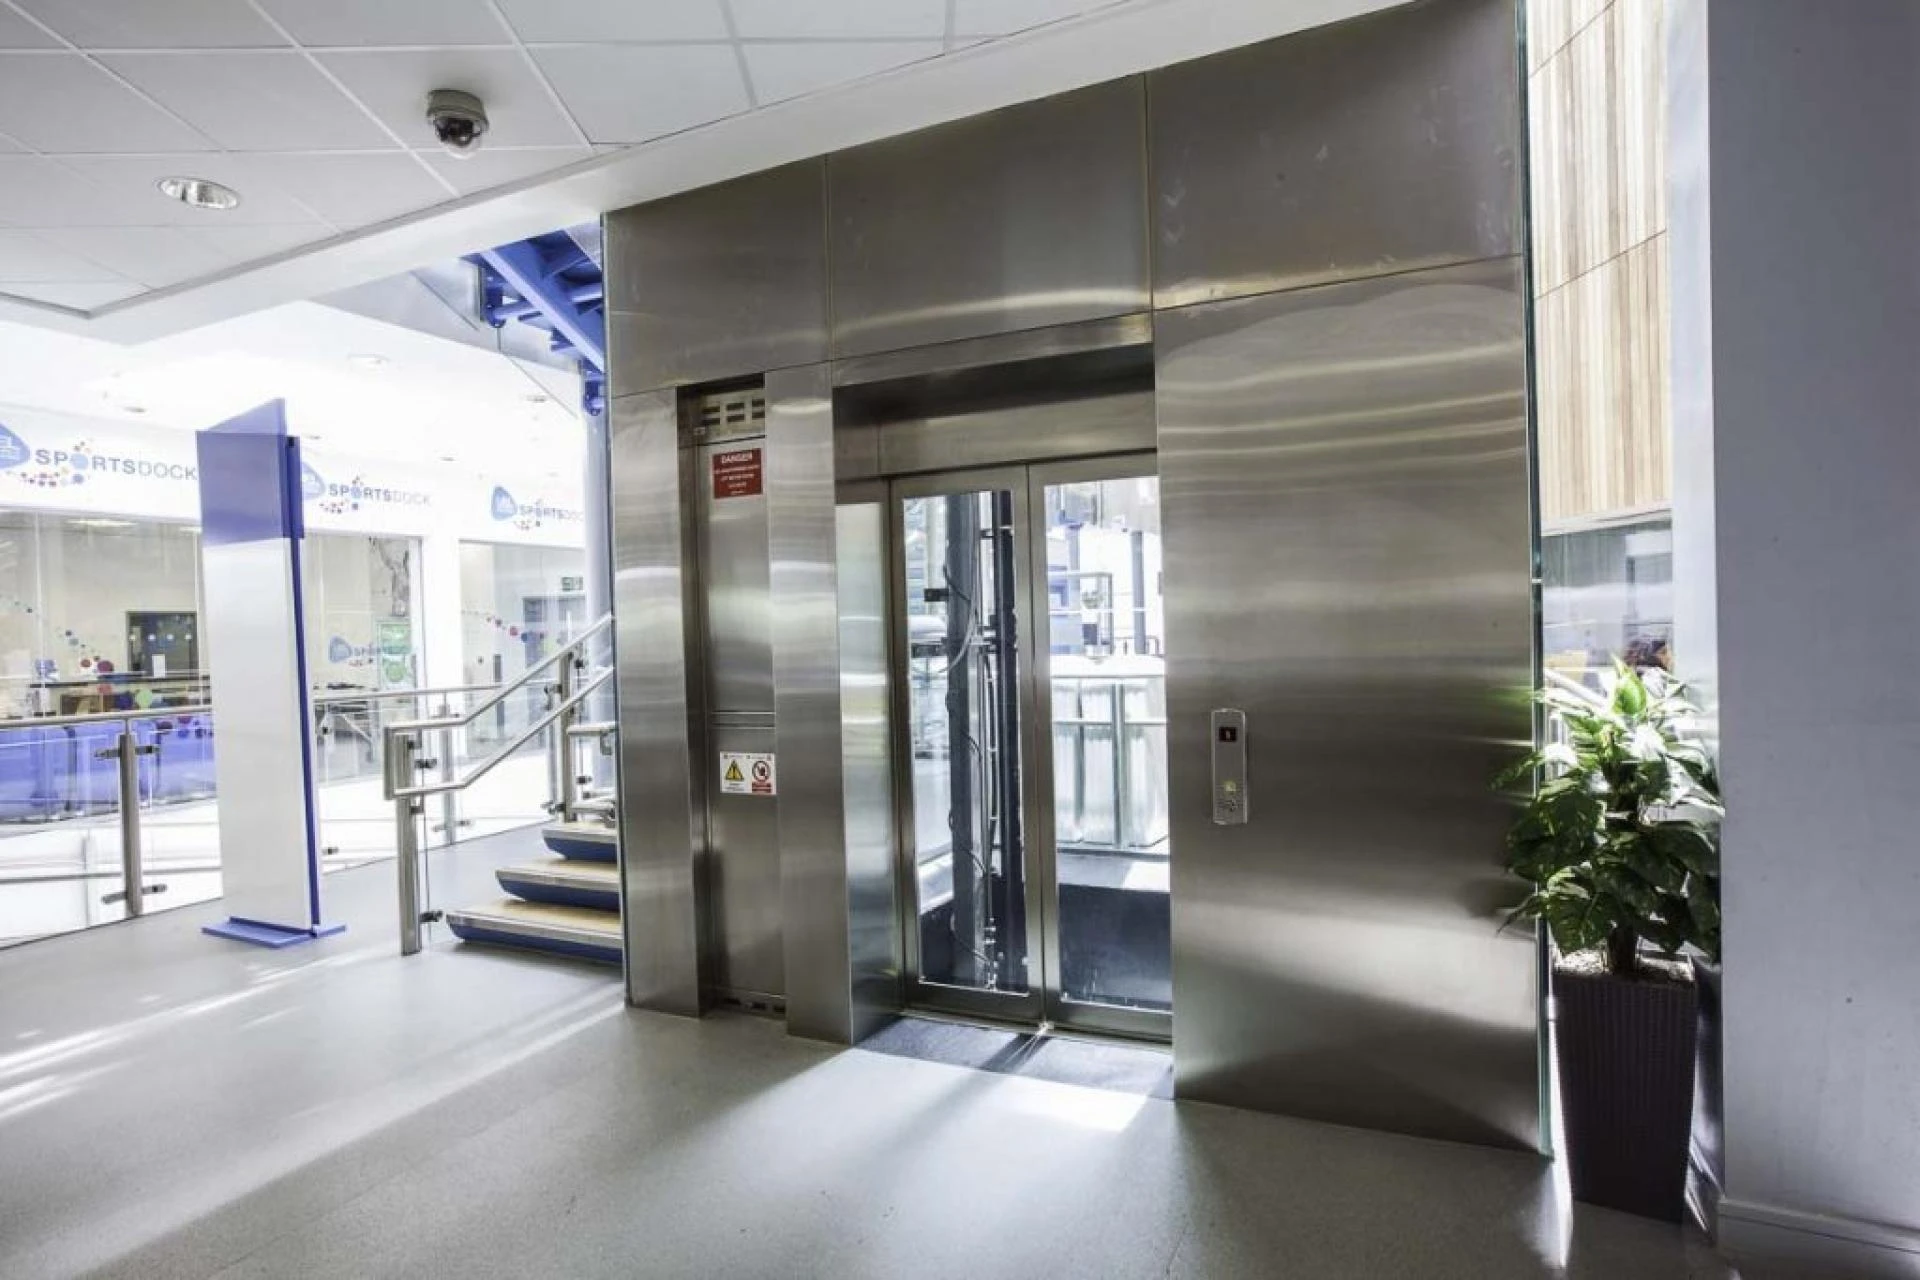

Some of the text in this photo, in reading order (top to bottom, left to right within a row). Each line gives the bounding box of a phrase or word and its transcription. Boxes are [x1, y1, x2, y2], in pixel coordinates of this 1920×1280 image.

[35, 449, 197, 480] SPORTSDOCK
[721, 452, 753, 464] DANGER
[329, 483, 431, 504] SPORTSDOCK
